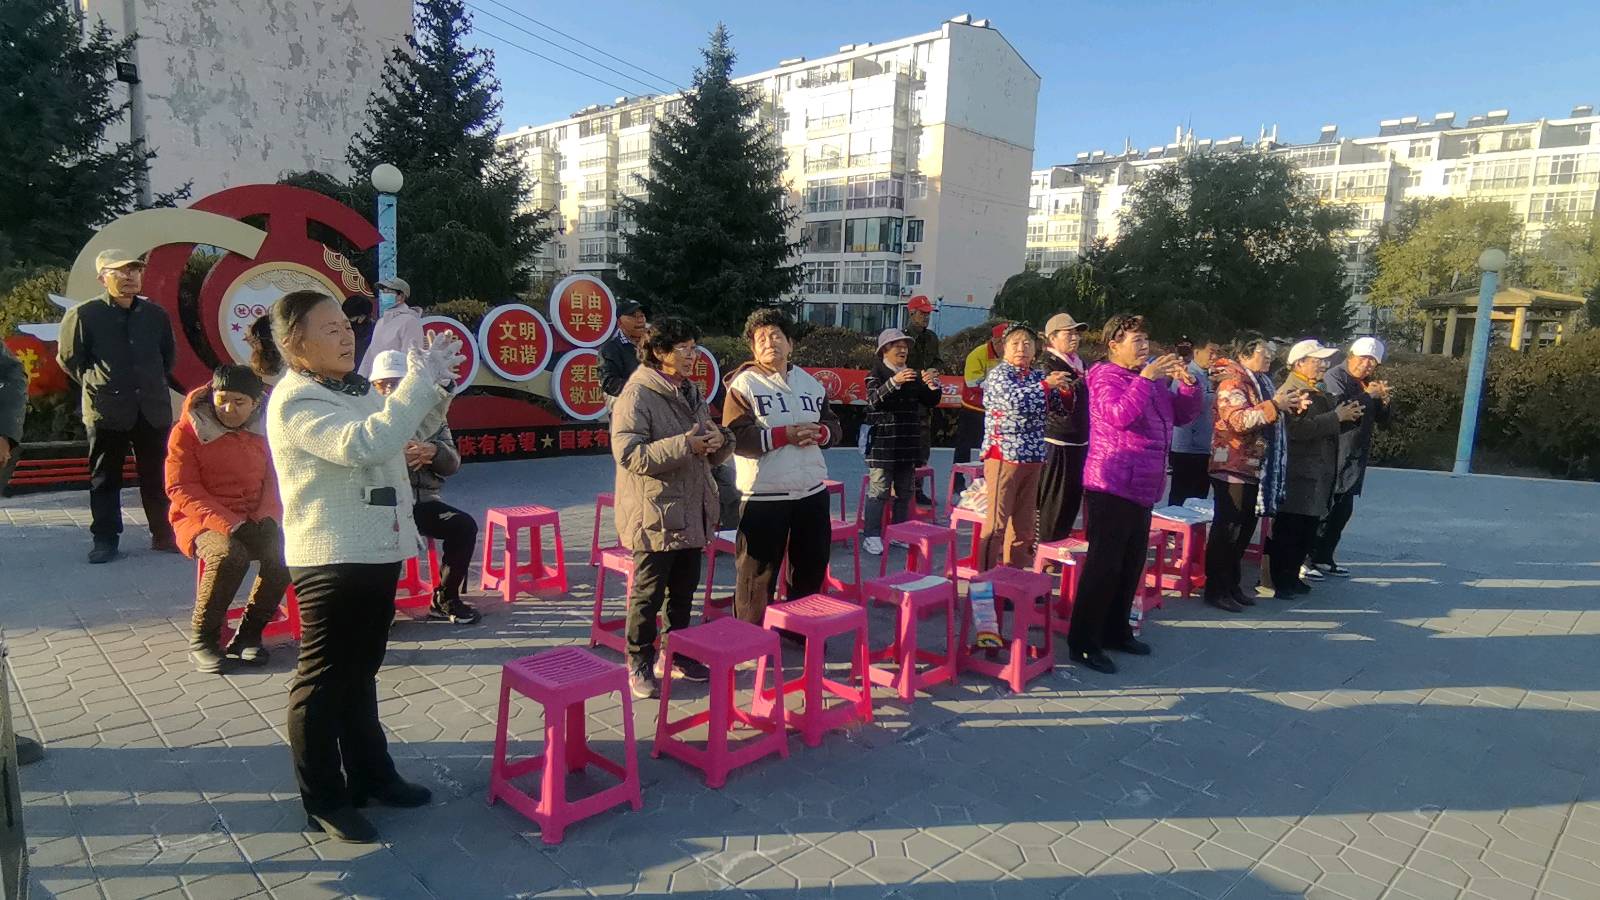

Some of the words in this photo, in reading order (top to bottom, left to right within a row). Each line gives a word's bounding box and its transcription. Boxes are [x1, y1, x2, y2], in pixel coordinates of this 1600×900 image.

[571, 291, 601, 309] 自由
[499, 320, 536, 340] 文明
[570, 313, 602, 331] 平等
[500, 345, 536, 364] 和谐
[571, 365, 600, 382] 爱国
[570, 387, 604, 404] 敬业
[457, 431, 537, 456] 族有希望
[559, 429, 609, 450] 国家有
